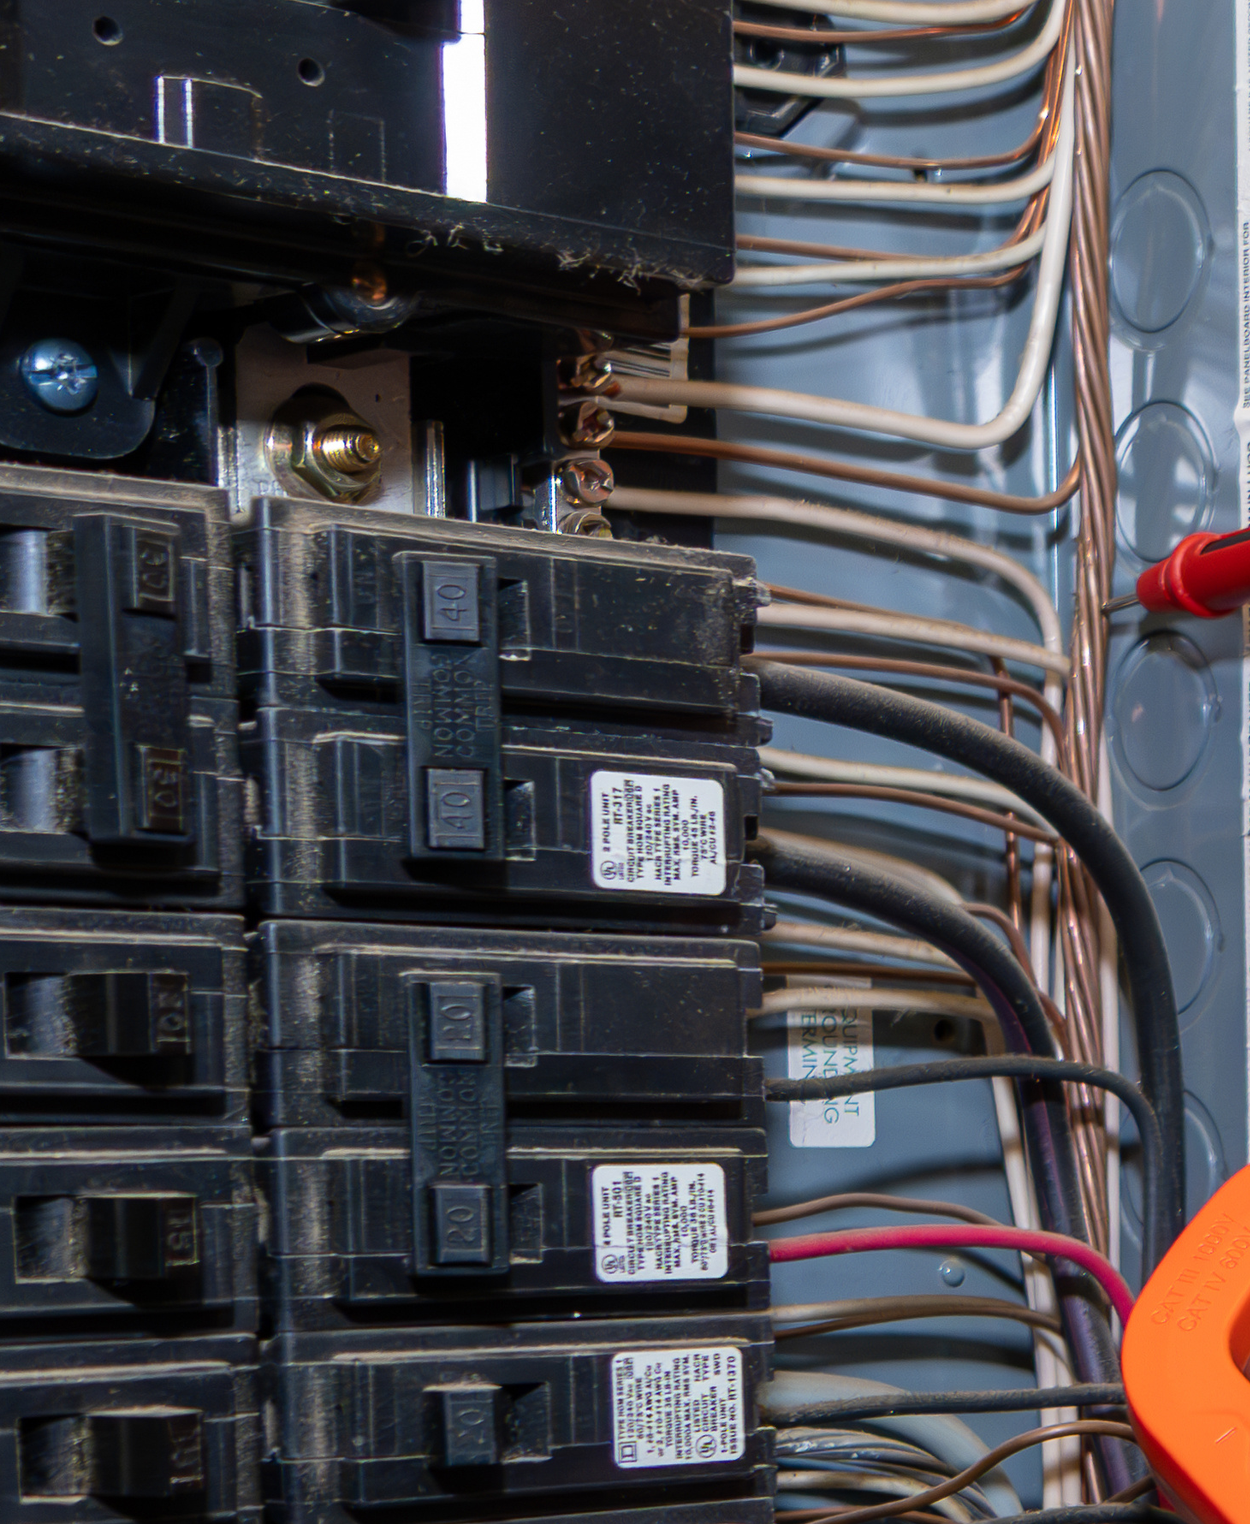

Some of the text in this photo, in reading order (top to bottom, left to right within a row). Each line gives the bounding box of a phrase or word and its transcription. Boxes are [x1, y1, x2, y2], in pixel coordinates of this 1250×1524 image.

[435, 583, 467, 622] 40
[440, 791, 473, 830] 40
[613, 787, 623, 824] RT-317
[446, 1205, 476, 1243] 20
[1151, 1213, 1234, 1325] CAT III 1000V
[1177, 1293, 1211, 1331] CAT
[1203, 1272, 1226, 1291] IV
